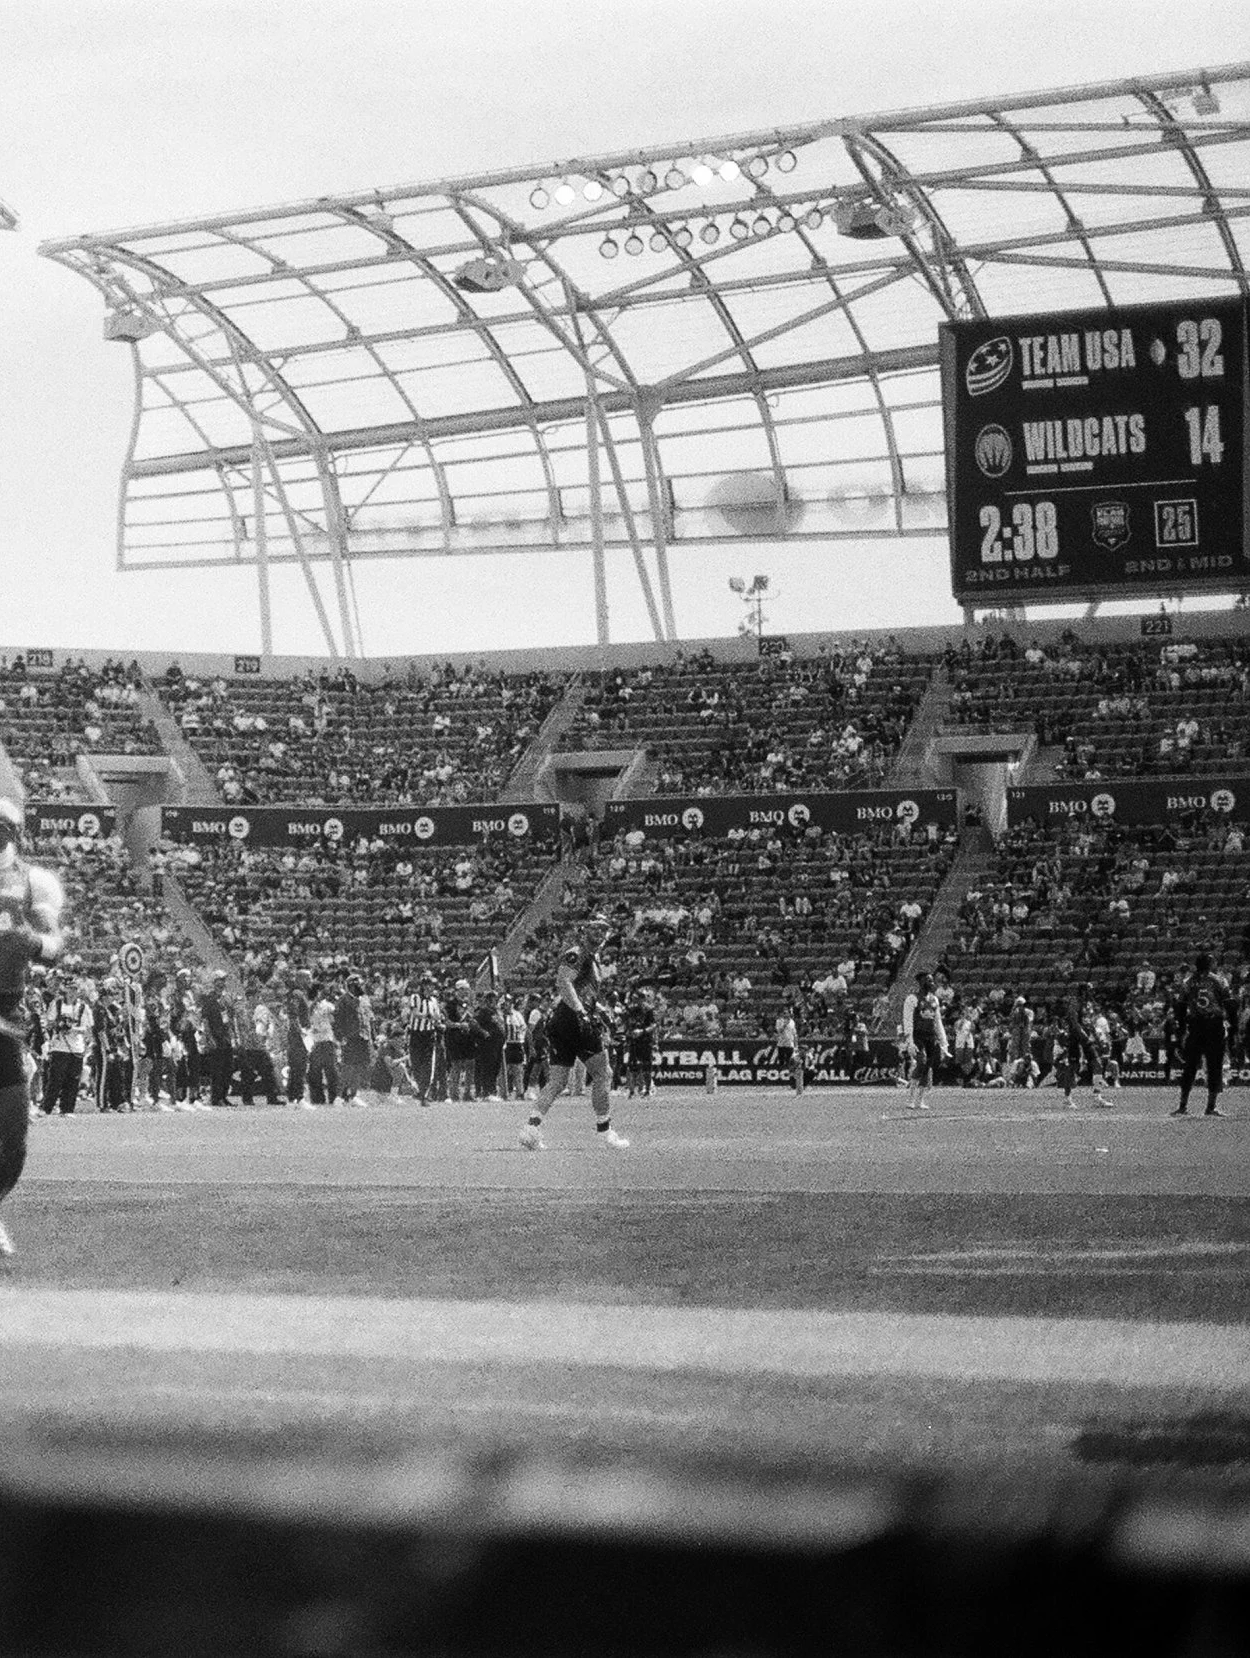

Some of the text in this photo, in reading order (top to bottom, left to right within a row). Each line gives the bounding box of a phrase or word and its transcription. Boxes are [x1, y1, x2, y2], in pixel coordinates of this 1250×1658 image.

[1018, 329, 1136, 376] TEAM USA
[1176, 318, 1224, 379] 32
[1022, 413, 1147, 461] WILDCATS
[1184, 405, 1224, 465] 14
[1162, 505, 1192, 541] 25
[979, 501, 1059, 562] 2:38
[1124, 558, 1172, 574] 2ND
[1190, 554, 1233, 571] MID
[965, 563, 1072, 583] 2ND HALF
[1145, 620, 1170, 633] 221
[1049, 801, 1087, 813] BMO
[1166, 796, 1206, 809] BMO
[644, 813, 679, 826] BMO
[749, 810, 785, 825] BMO
[856, 807, 893, 821] BMO
[40, 818, 75, 831] BMO
[192, 821, 226, 834] BMO
[288, 822, 321, 835] BMO
[379, 823, 412, 836] BMO
[472, 820, 505, 833] BMO
[713, 1069, 752, 1081] LAG
[1105, 1071, 1166, 1079] FNATICS
